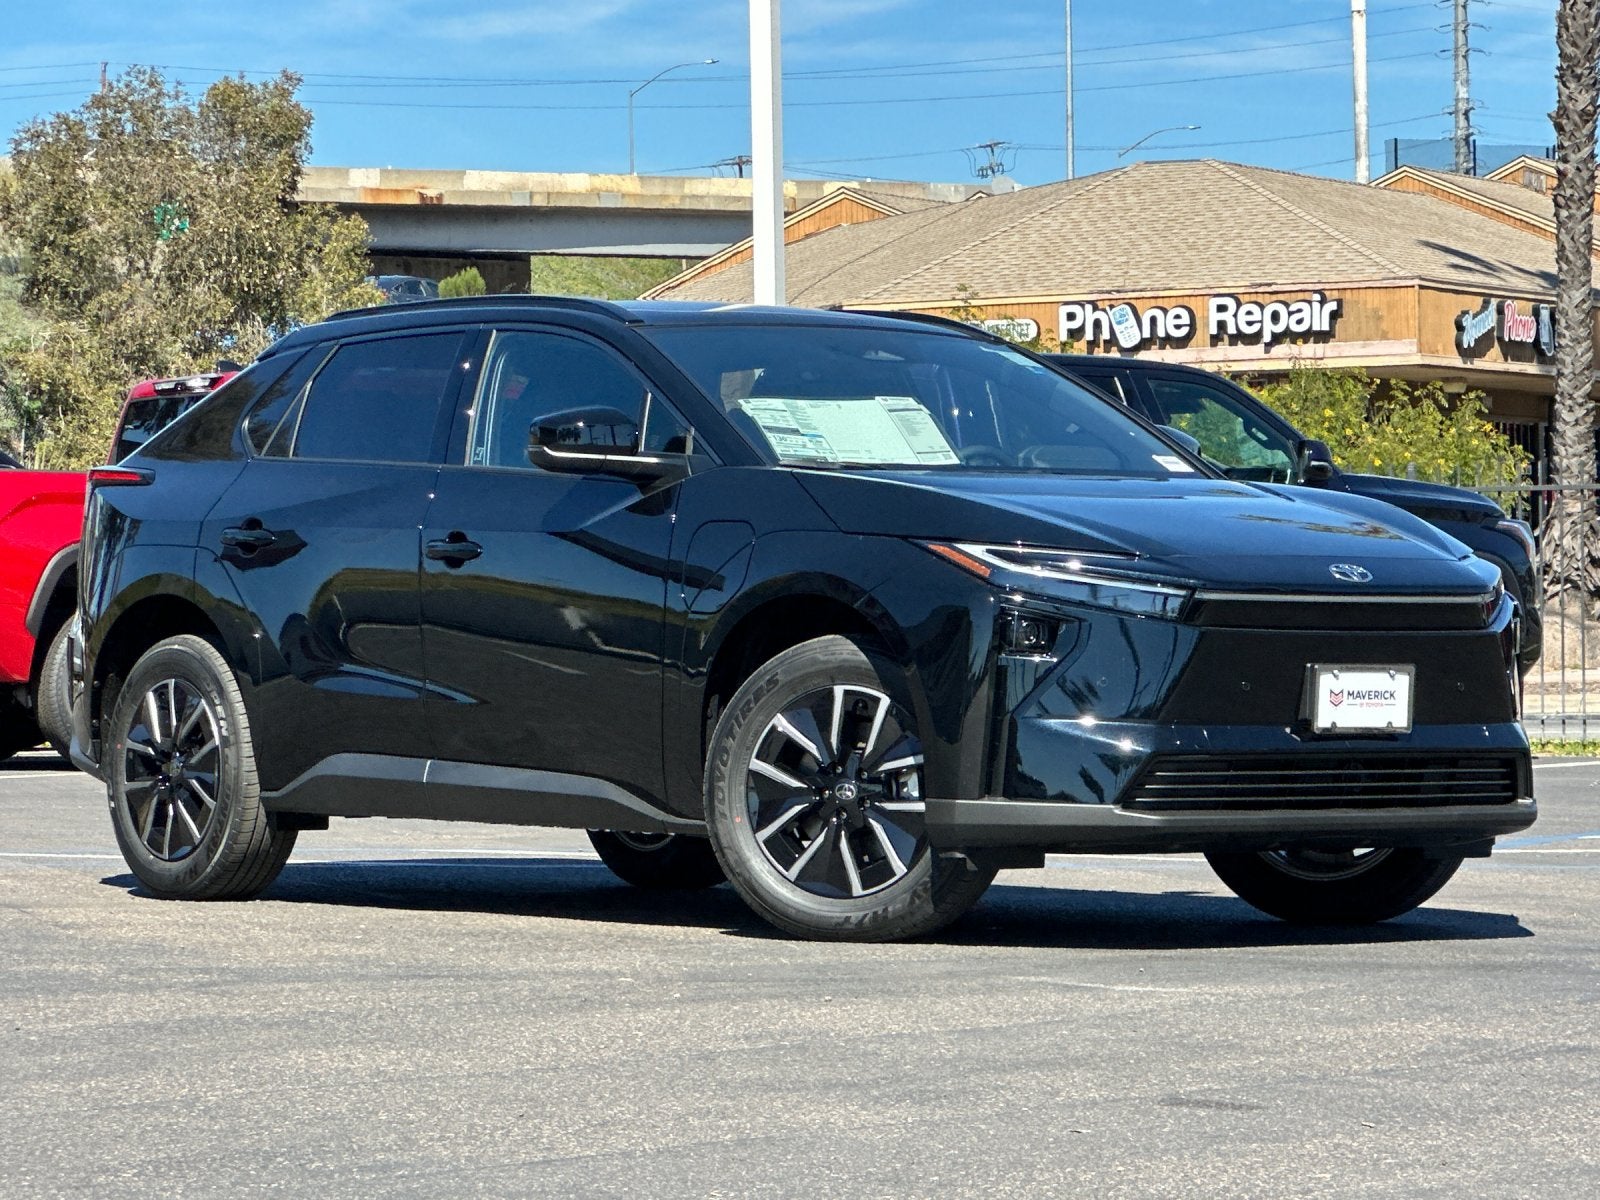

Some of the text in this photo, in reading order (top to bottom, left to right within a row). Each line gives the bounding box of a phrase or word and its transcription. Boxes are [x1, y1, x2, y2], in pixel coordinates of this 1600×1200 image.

[1058, 293, 1338, 348] Phne Repair
[1504, 299, 1537, 343] Phone
[725, 671, 781, 745] TIRES
[1347, 690, 1396, 700] MAVERICK
